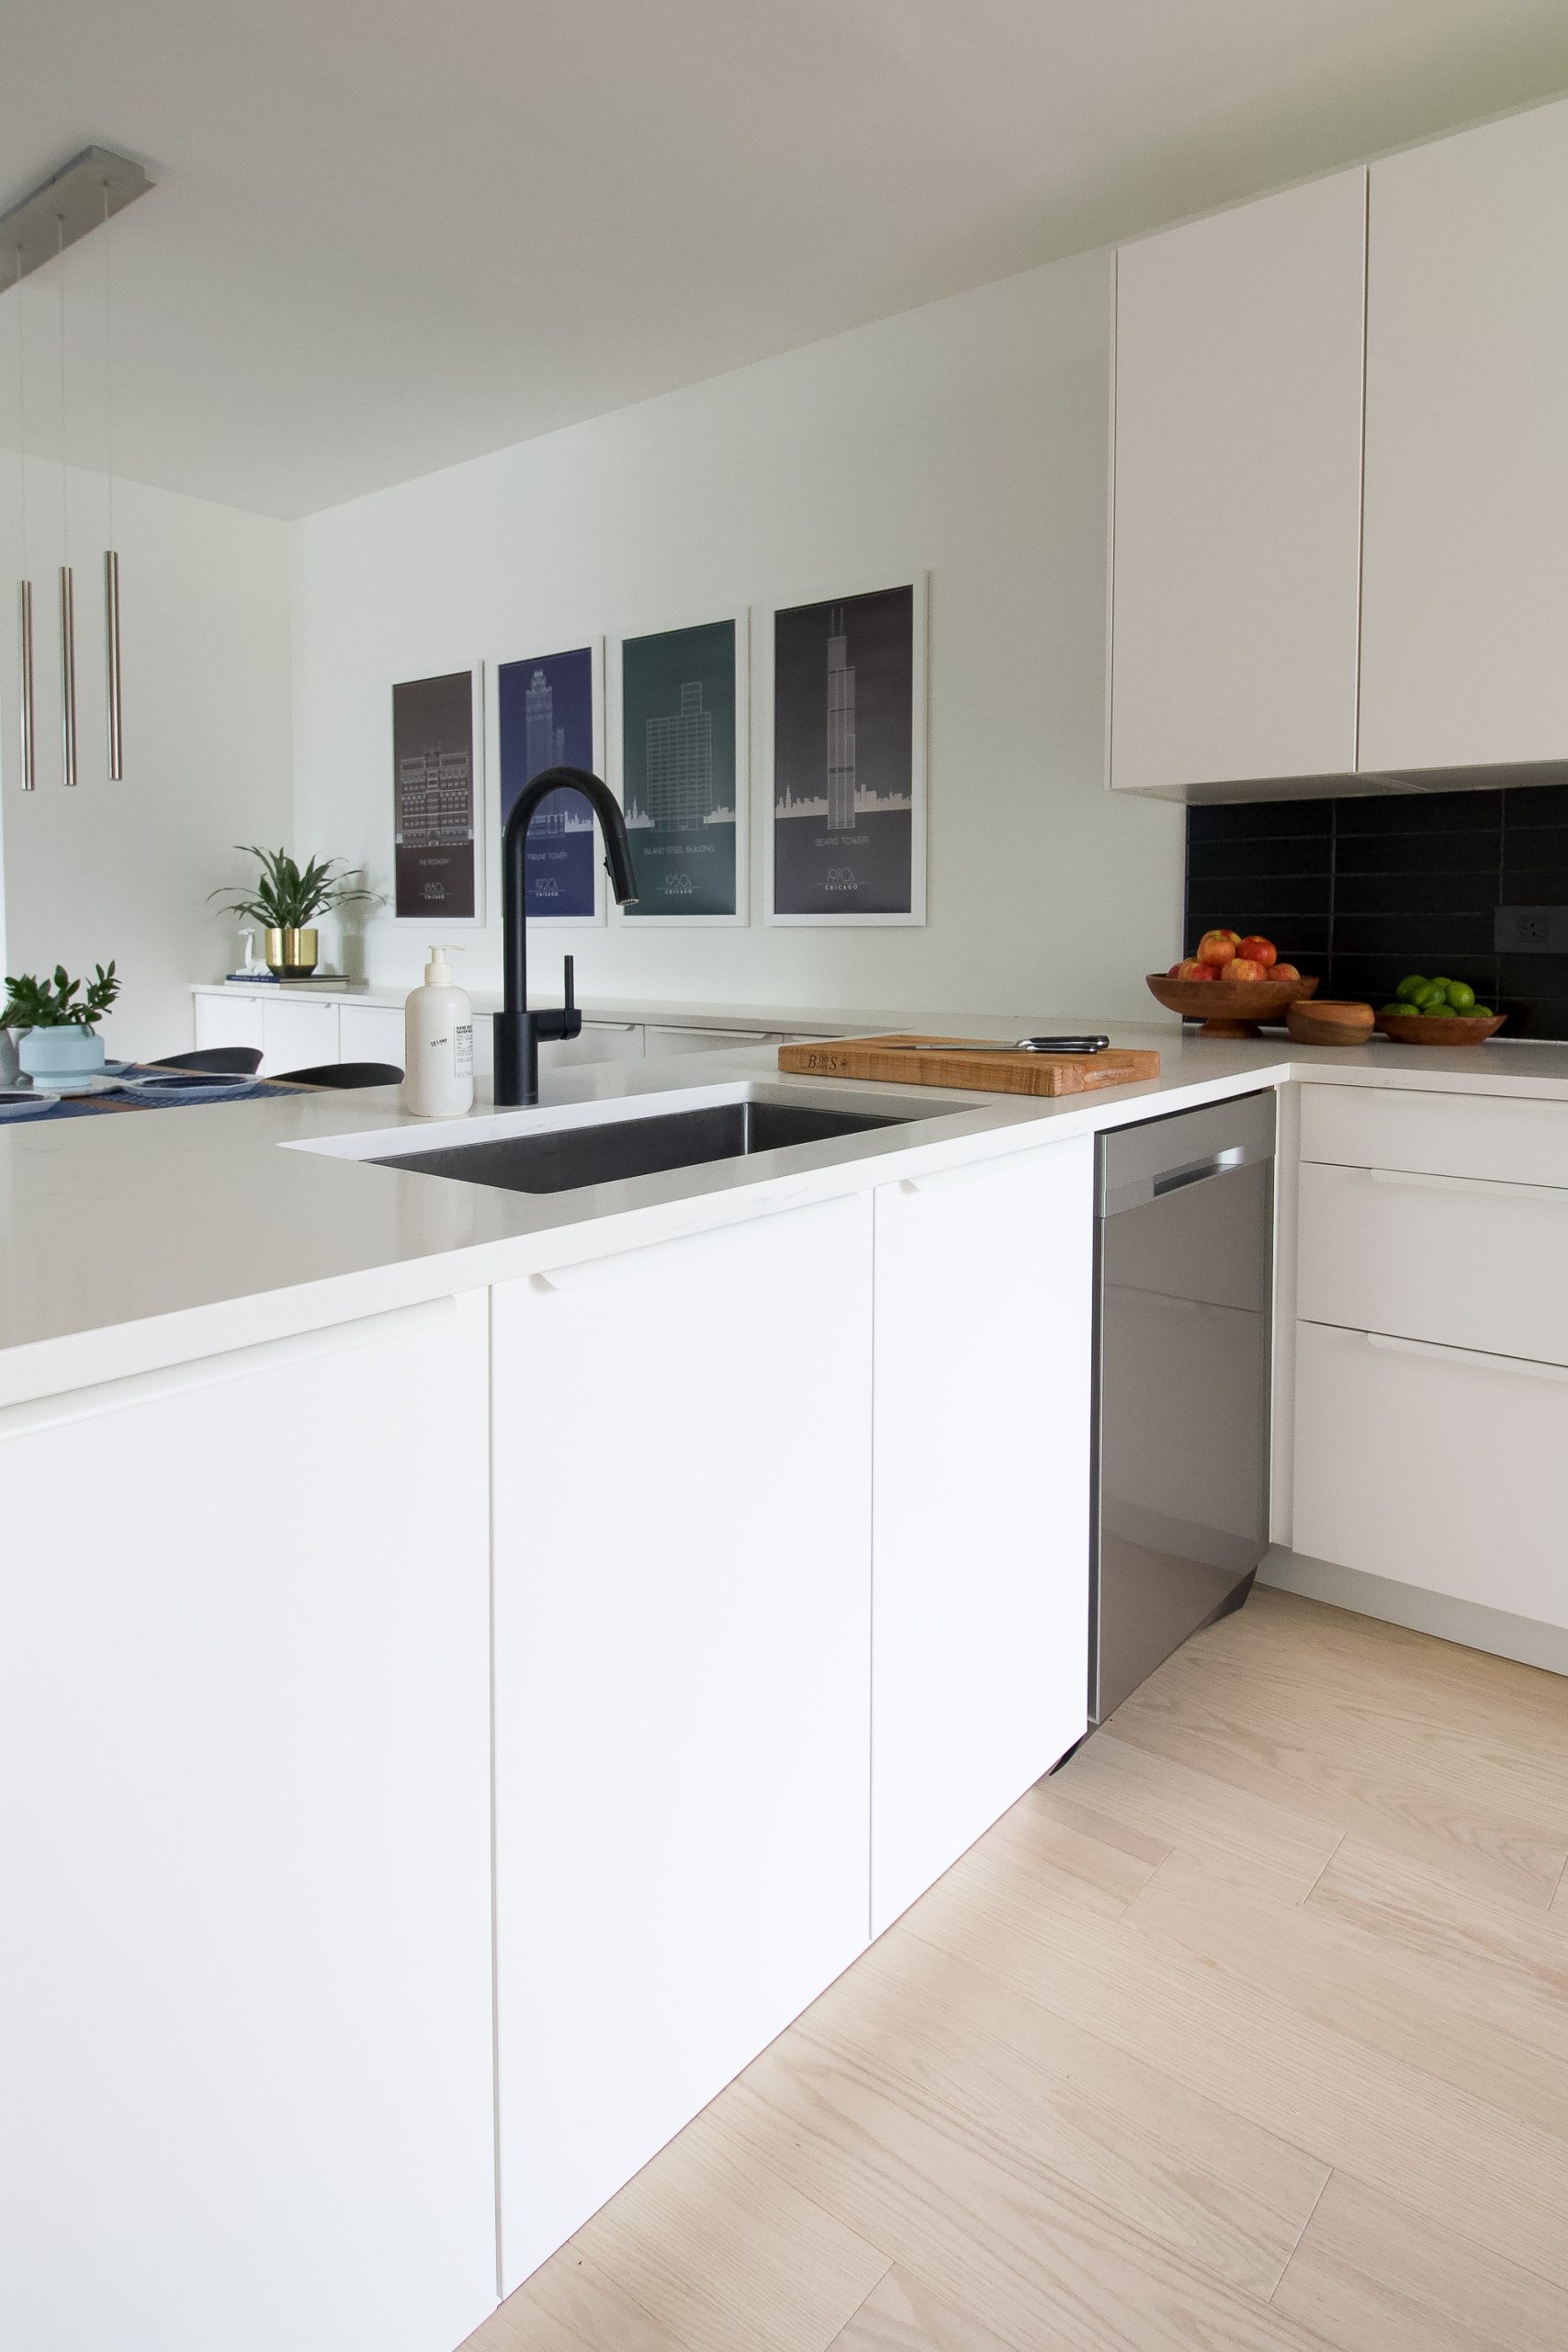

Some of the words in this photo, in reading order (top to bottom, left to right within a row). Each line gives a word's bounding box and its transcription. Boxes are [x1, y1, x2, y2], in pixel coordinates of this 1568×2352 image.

[815, 838, 839, 847] SEARS
[841, 835, 869, 845] TOWER
[666, 845, 683, 854] STEEL
[685, 844, 715, 854] BUILDING
[548, 851, 568, 860] TOWER
